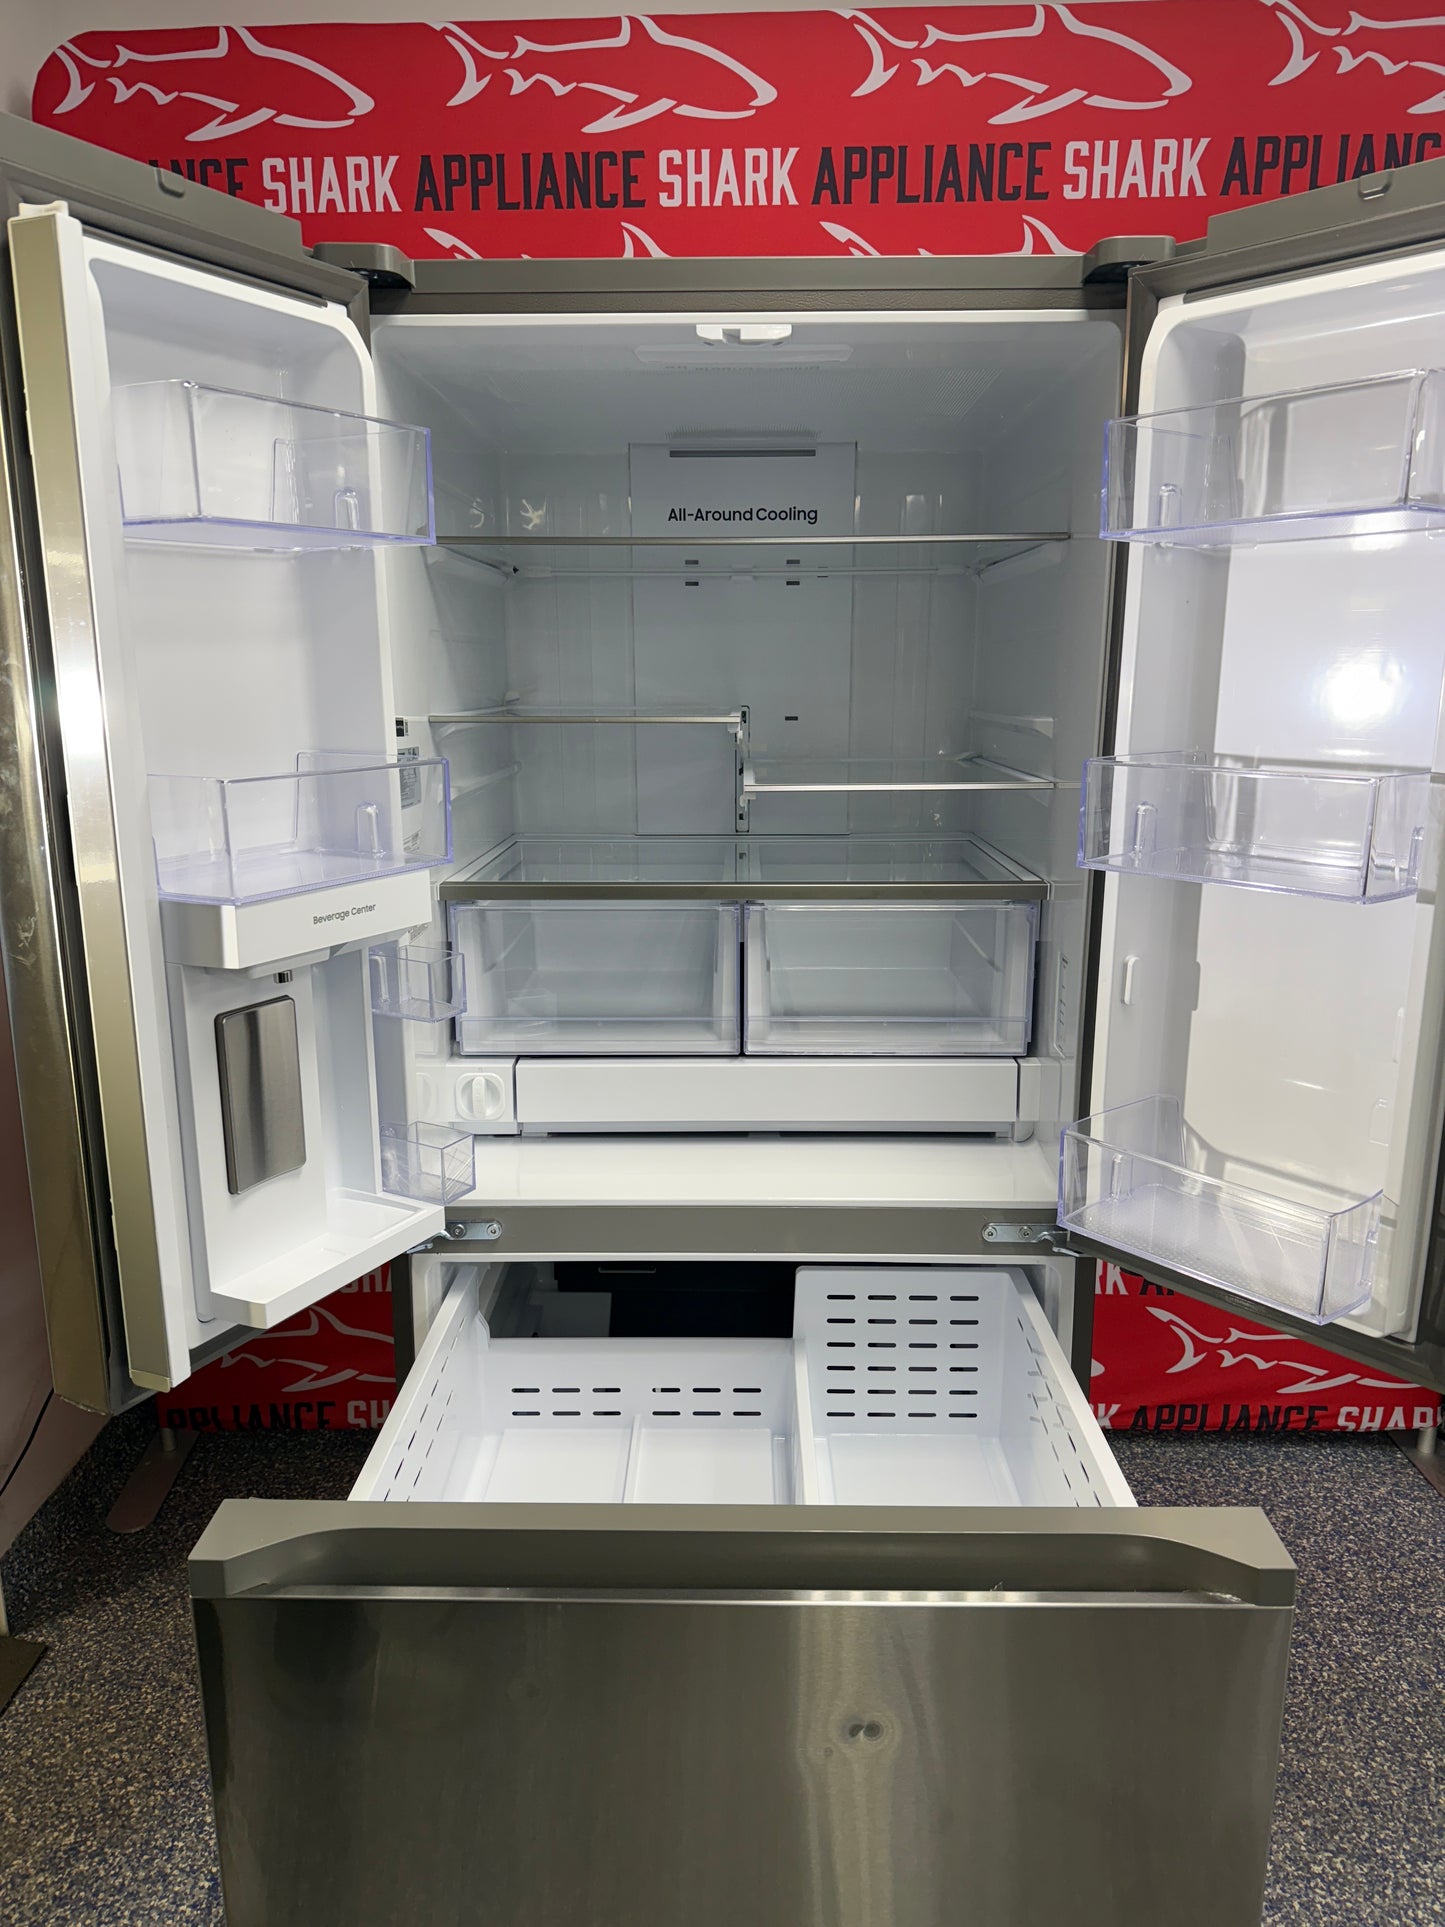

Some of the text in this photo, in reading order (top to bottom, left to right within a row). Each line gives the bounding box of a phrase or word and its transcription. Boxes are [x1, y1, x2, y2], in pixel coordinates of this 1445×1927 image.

[262, 155, 402, 214] SHARK
[414, 150, 646, 211] APPLIANCE
[658, 147, 799, 207] SHARK
[811, 142, 1052, 205] APPLIANCE
[1063, 138, 1211, 200] SHARK
[1219, 132, 1442, 196] APPLIANC
[667, 506, 818, 525] All-Around Cooling
[313, 904, 376, 924] Beverage Center
[1131, 1403, 1328, 1432] APPLIANCE
[1337, 1406, 1442, 1432] SHAR
